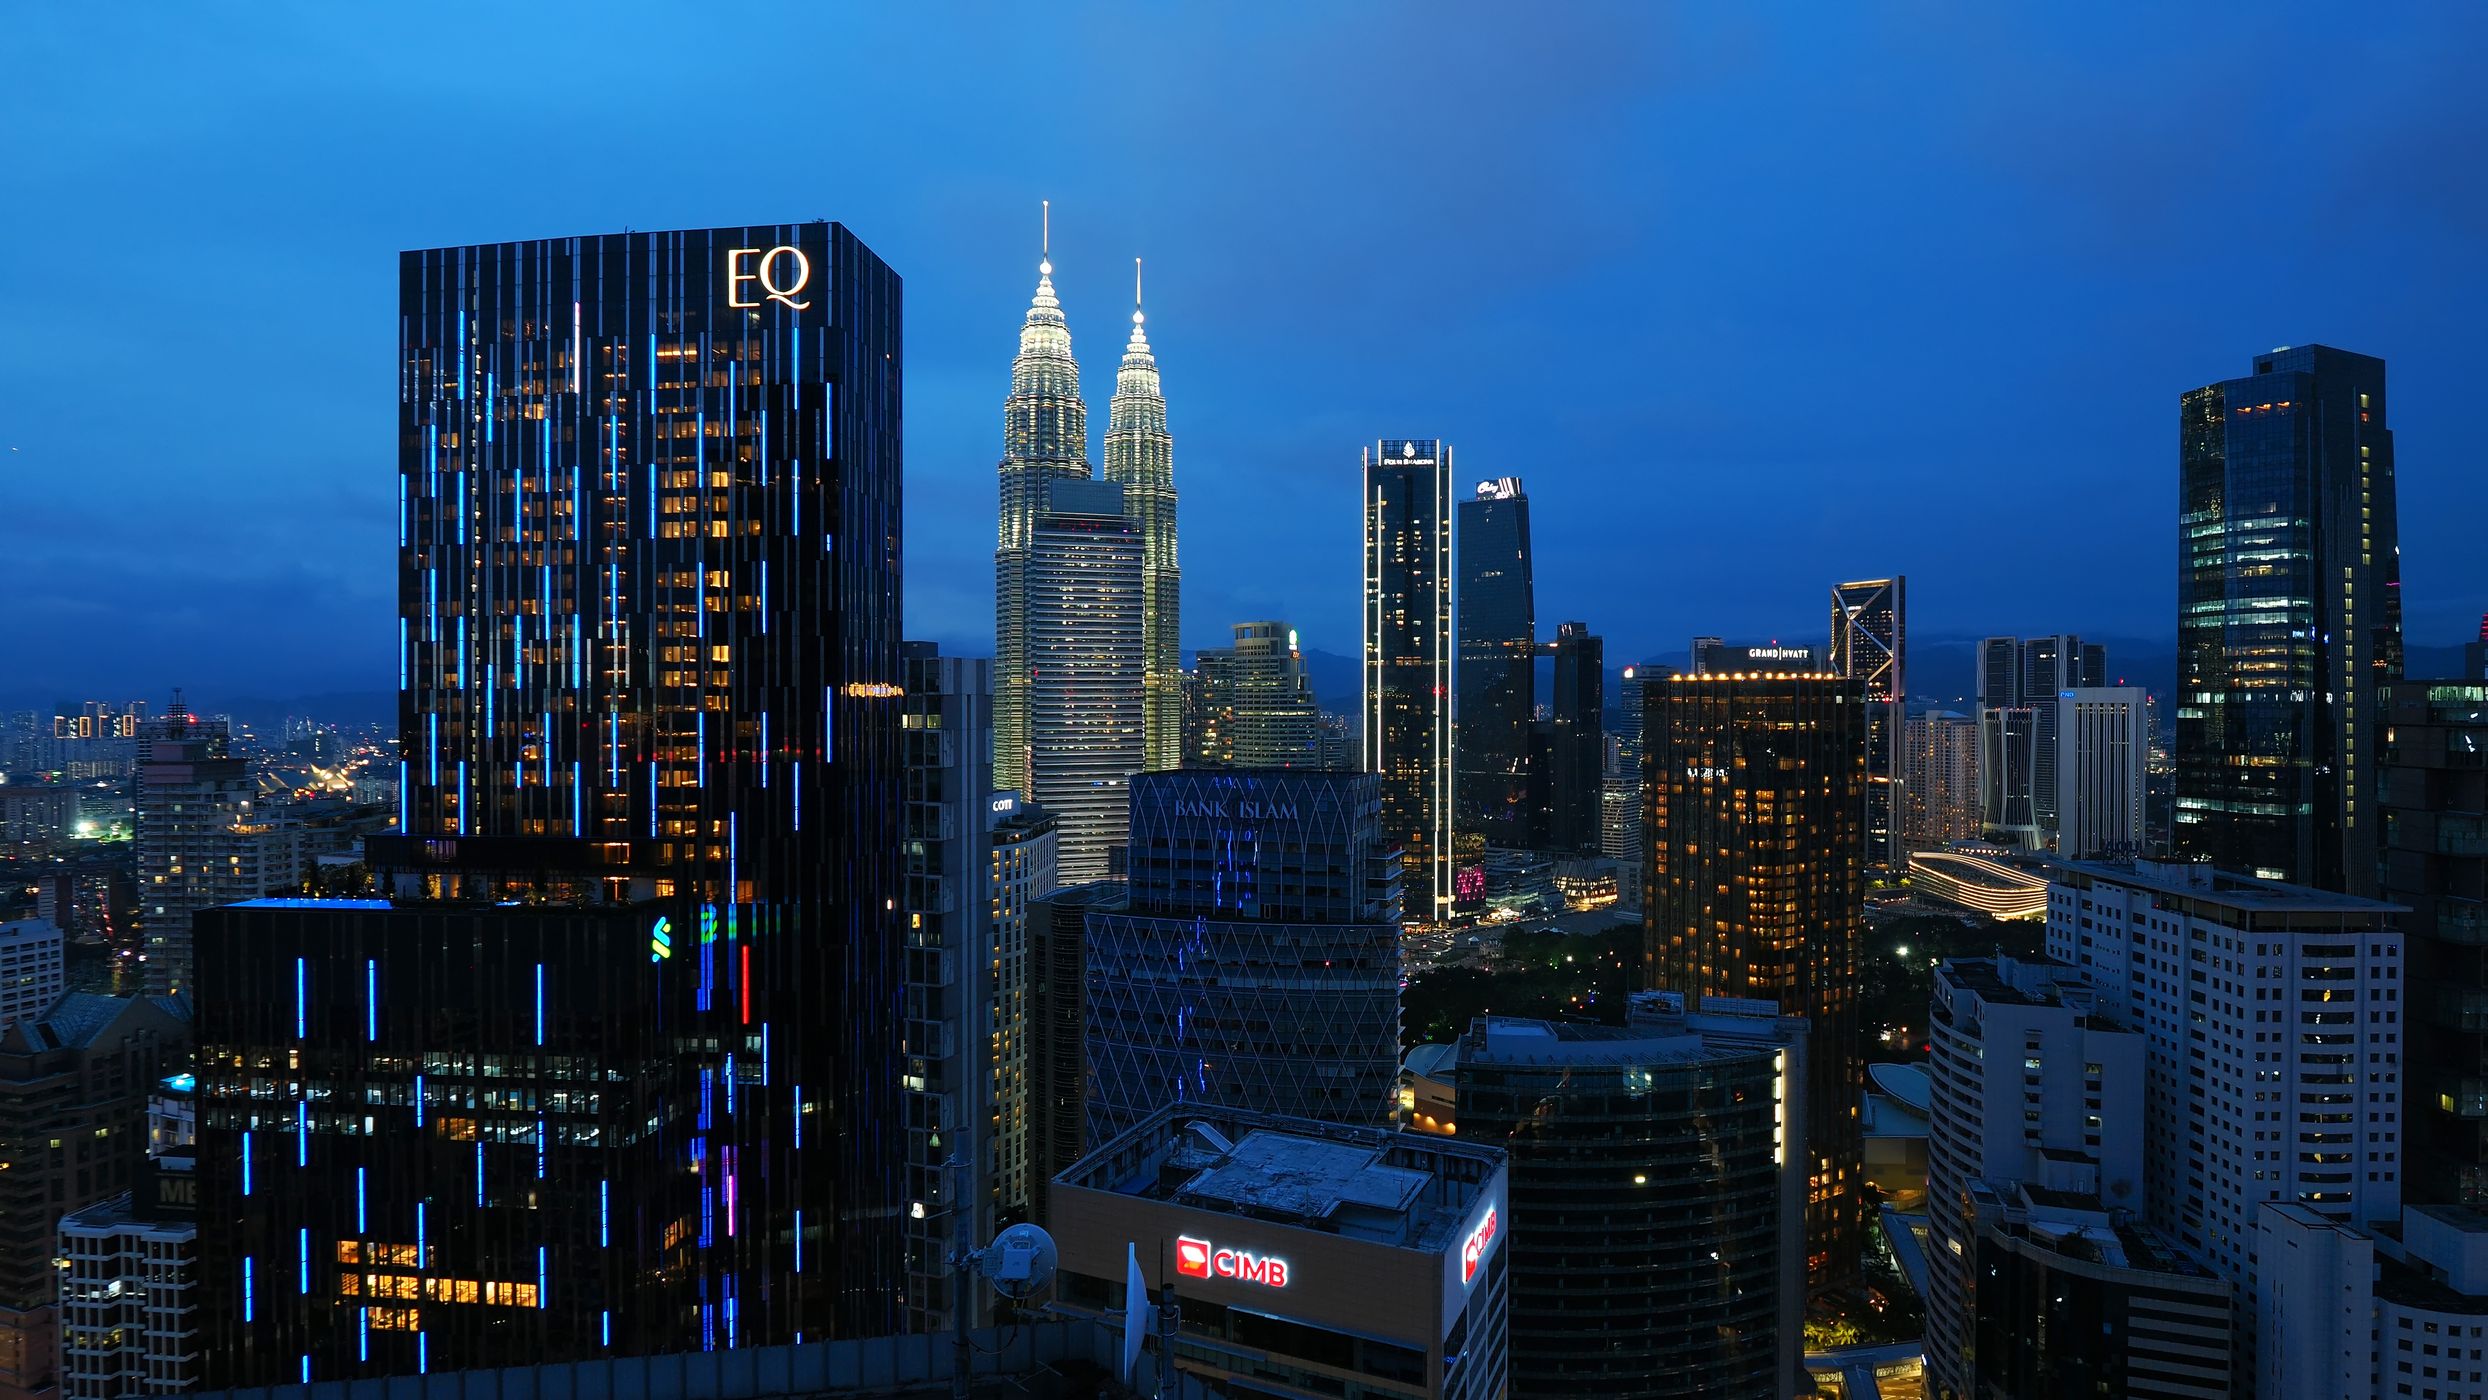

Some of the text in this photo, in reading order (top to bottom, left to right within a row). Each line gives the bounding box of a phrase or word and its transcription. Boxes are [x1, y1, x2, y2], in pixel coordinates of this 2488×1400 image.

[728, 246, 810, 309] EQ
[1749, 648, 1808, 659] GRAND HYATT
[1175, 800, 1299, 819] BANK ISLAM
[1213, 1248, 1288, 1288] CIMB
